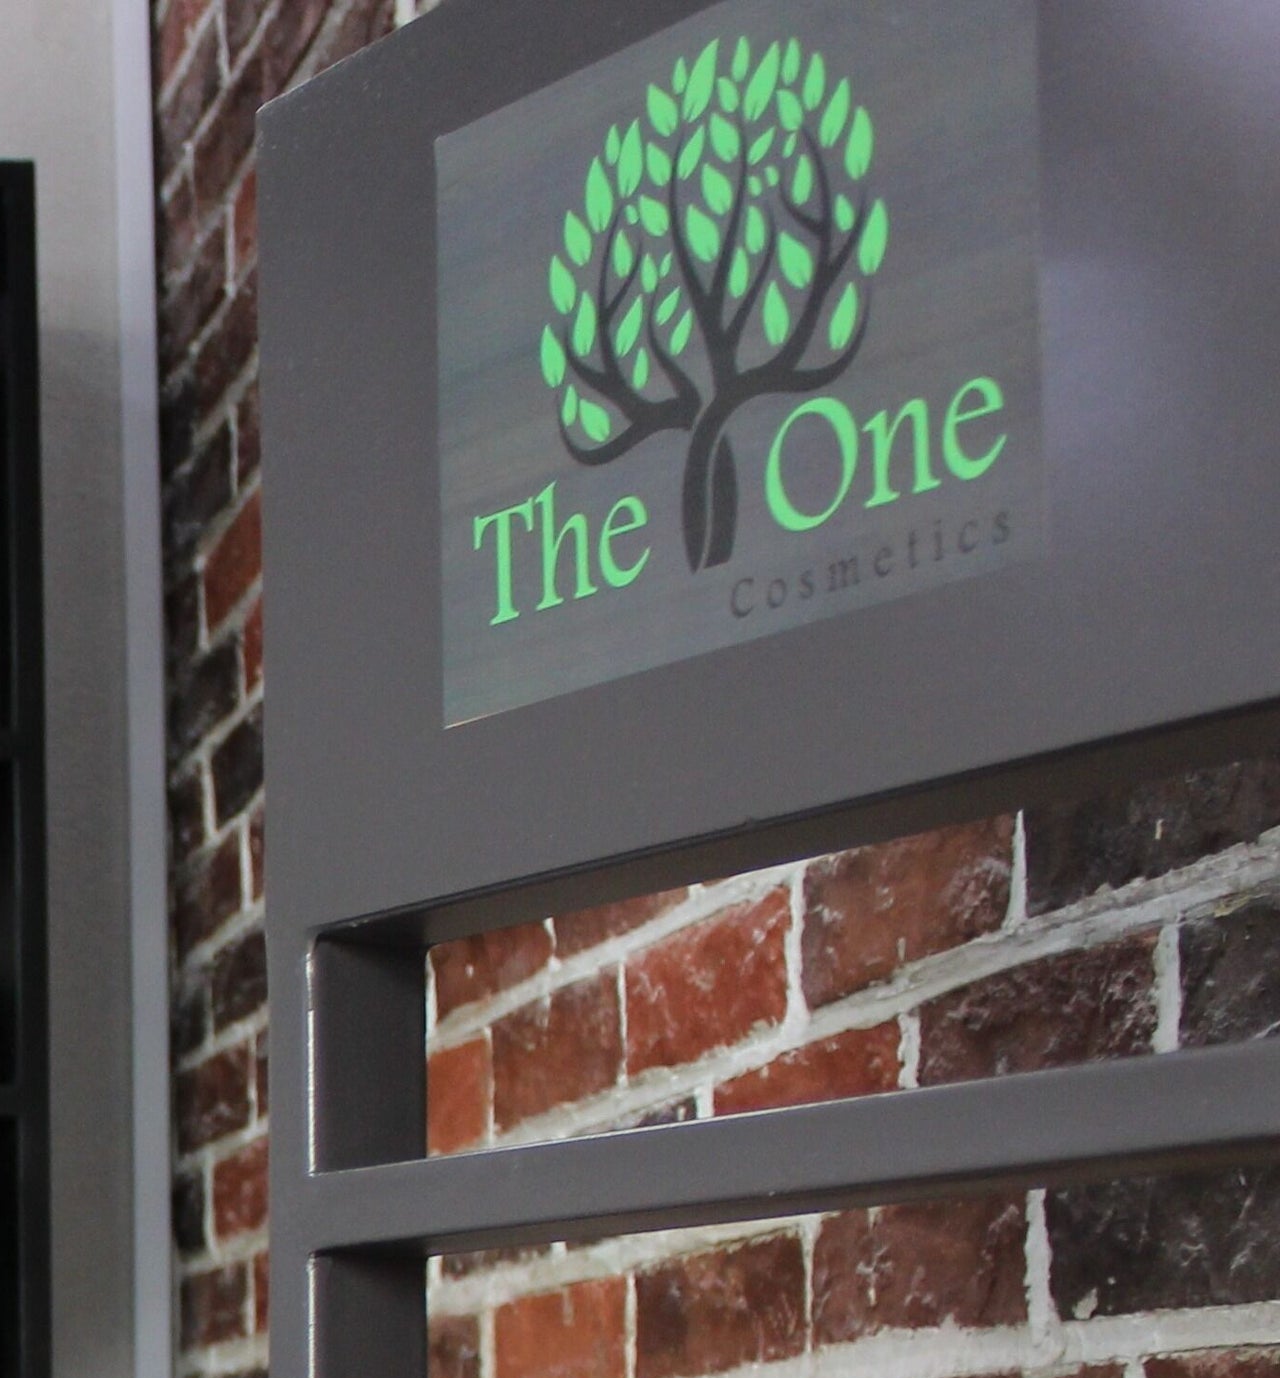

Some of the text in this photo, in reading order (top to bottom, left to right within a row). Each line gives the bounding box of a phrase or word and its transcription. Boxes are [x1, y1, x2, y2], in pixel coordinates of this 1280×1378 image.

[472, 376, 1008, 625] The One
[730, 510, 1011, 619] Cosmetics
